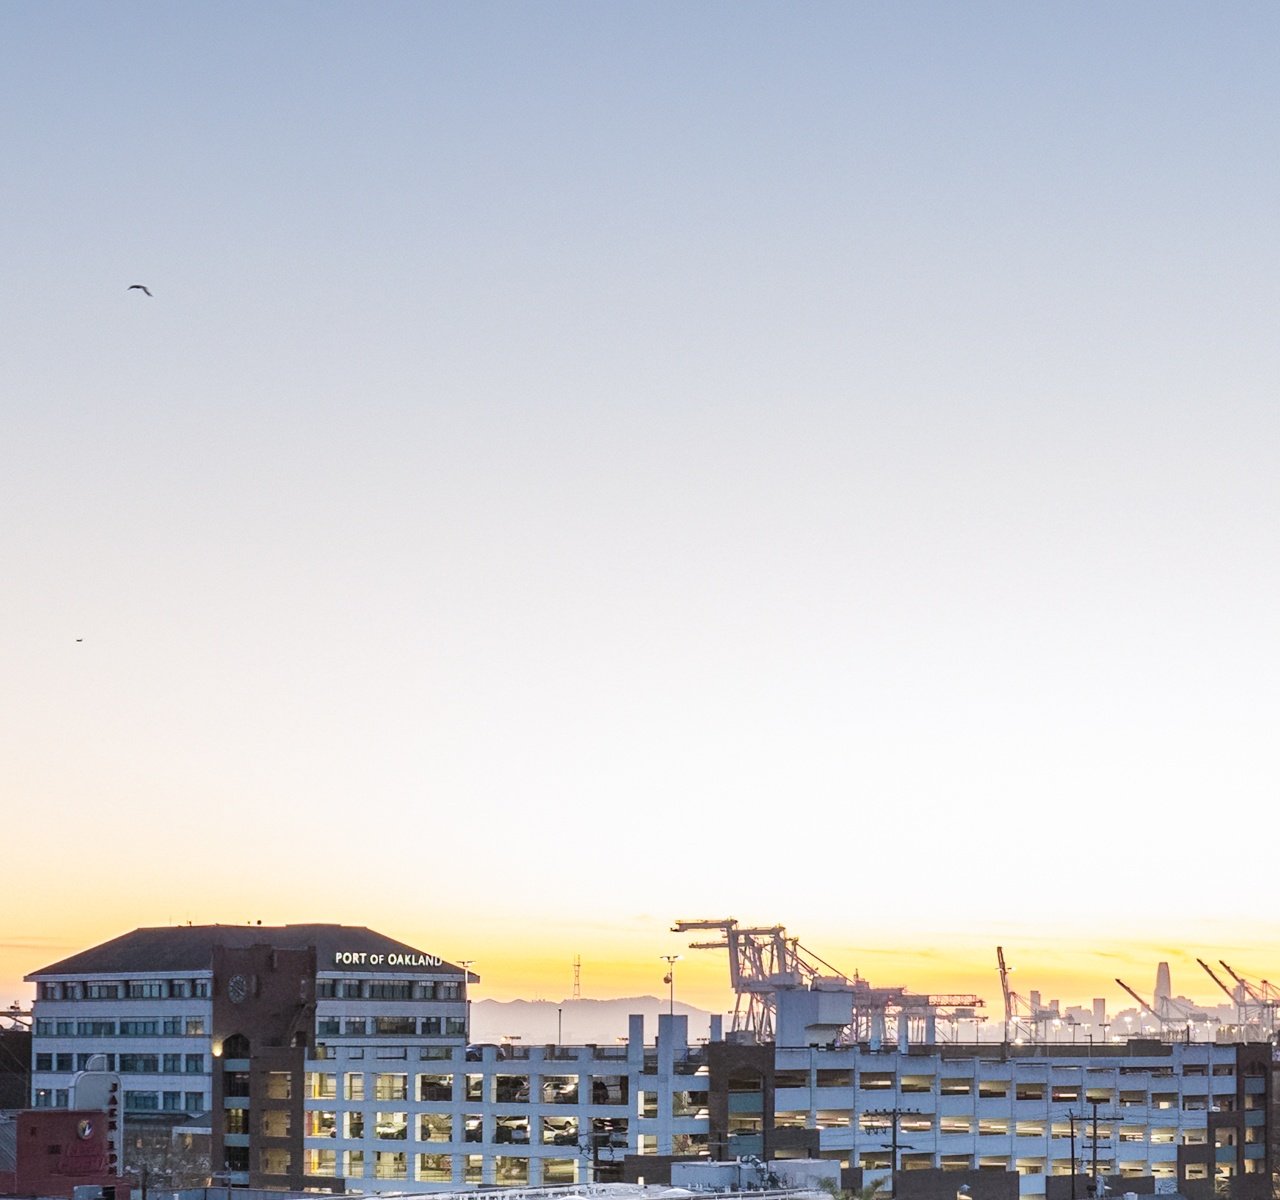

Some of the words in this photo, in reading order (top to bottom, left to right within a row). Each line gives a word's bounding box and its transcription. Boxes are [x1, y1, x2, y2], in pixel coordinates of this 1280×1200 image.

[335, 952, 367, 964] PORT
[370, 954, 384, 965] OF
[387, 953, 443, 966] OAKLAND
